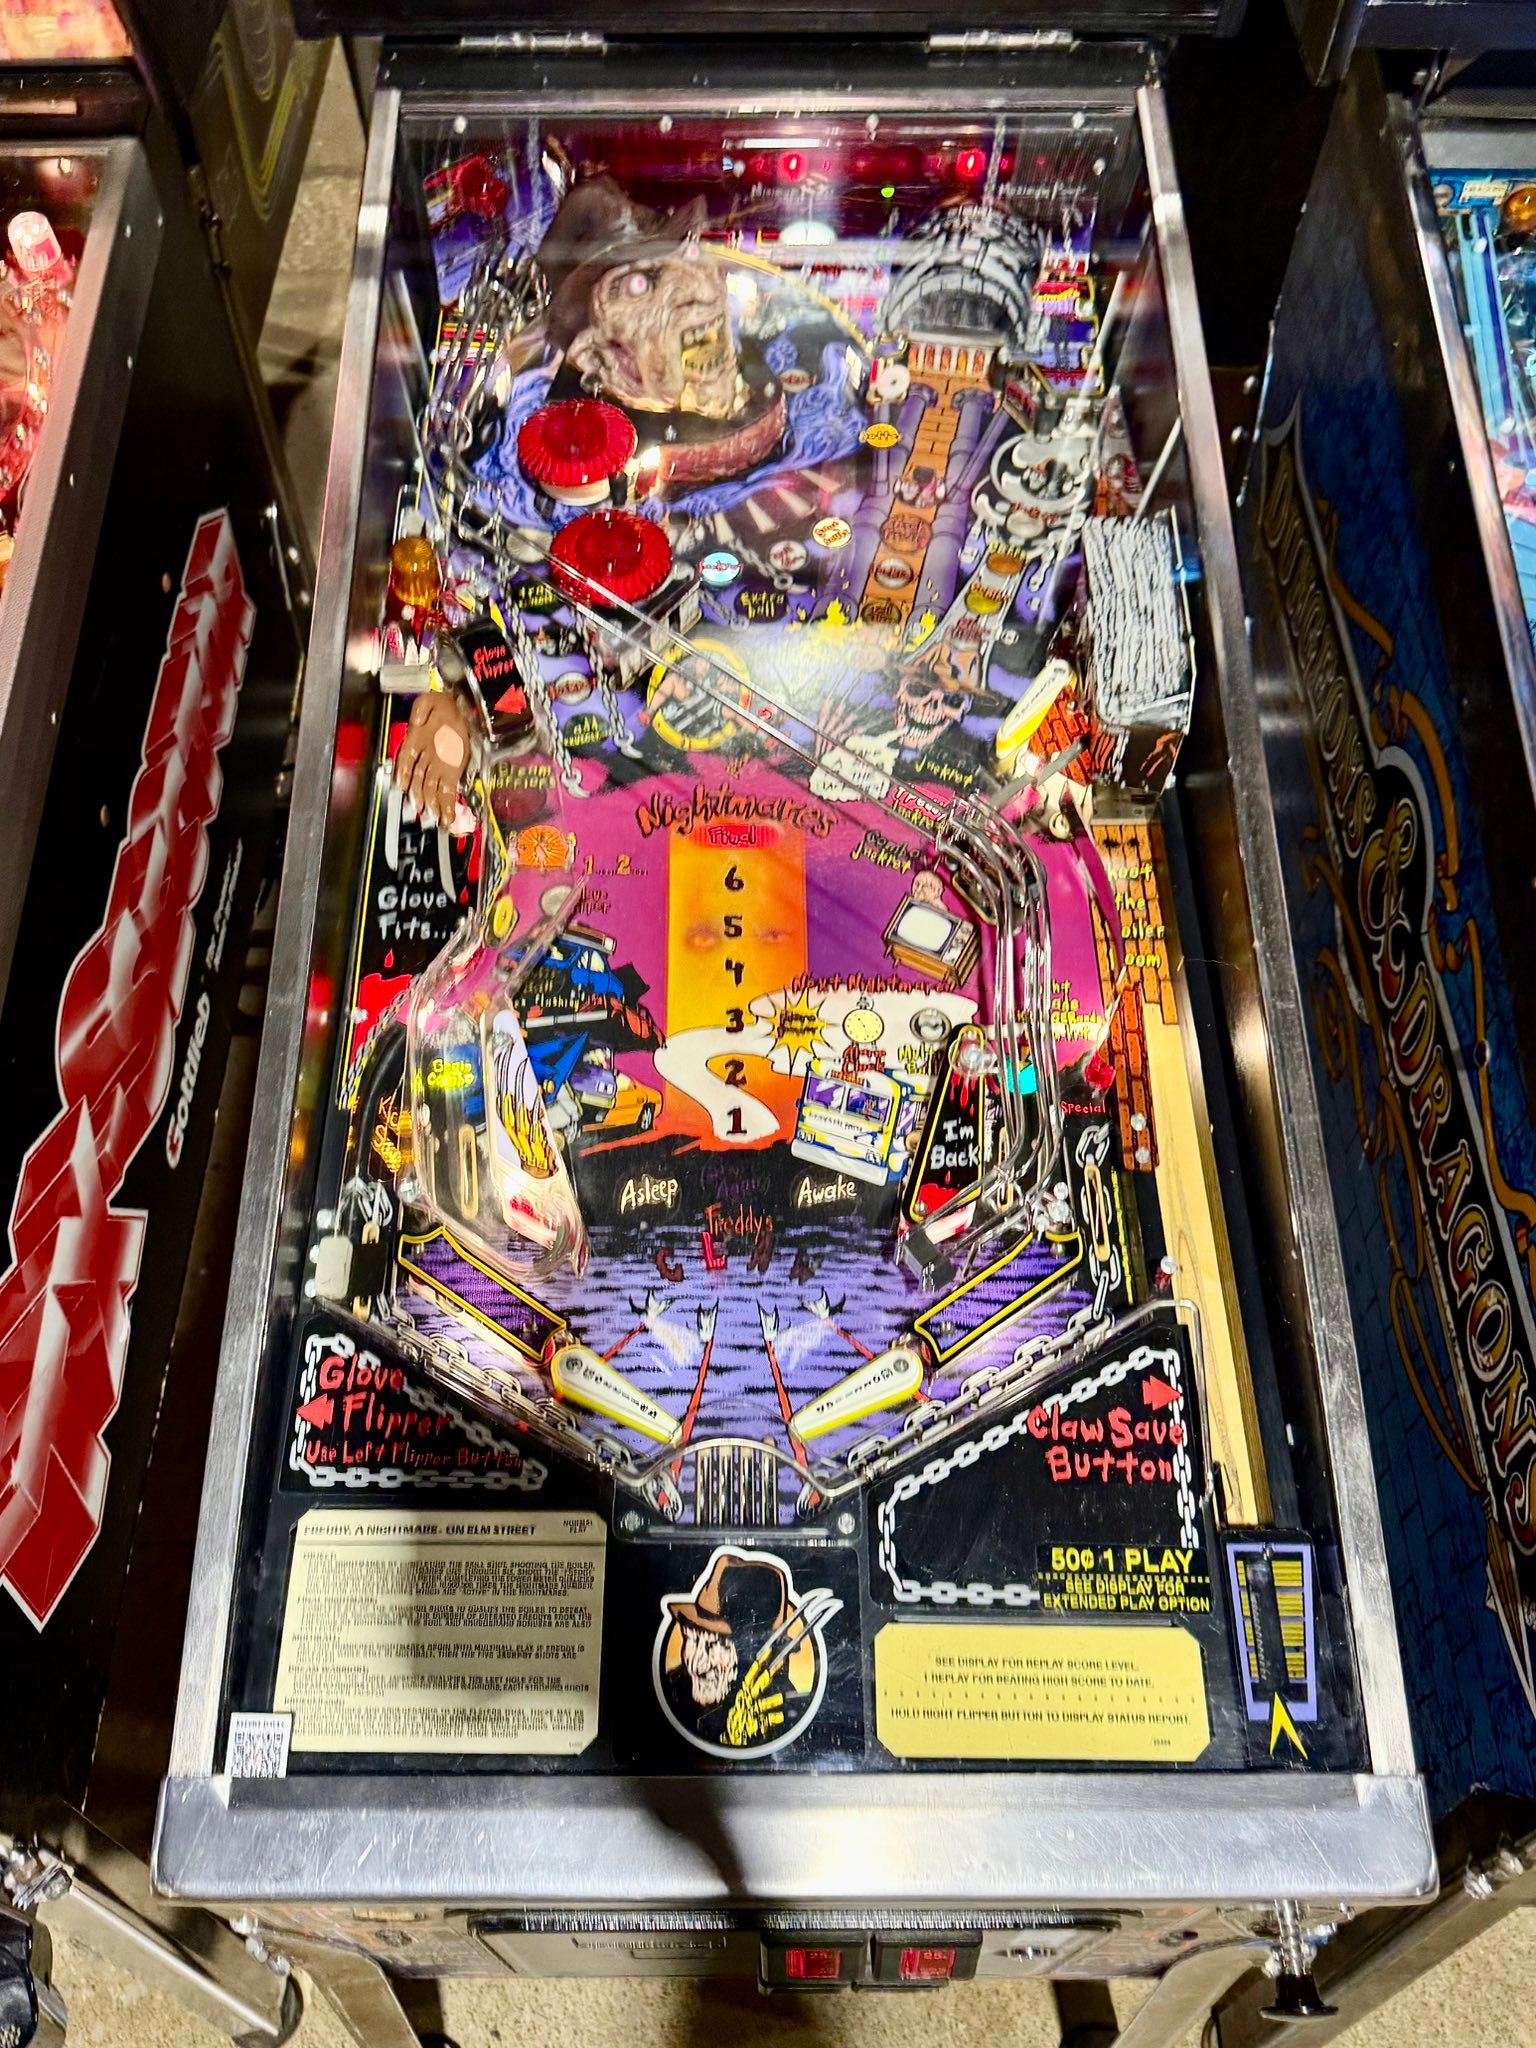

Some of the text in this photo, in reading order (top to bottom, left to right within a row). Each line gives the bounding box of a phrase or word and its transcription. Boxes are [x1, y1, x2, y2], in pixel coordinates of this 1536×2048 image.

[635, 783, 838, 838] Nightmares
[708, 825, 756, 845] Final
[398, 857, 434, 884] The
[724, 866, 744, 891] 6
[378, 885, 447, 911] Glove
[724, 915, 742, 938] 5
[725, 958, 744, 986] 4
[791, 972, 841, 993] Next
[725, 1008, 744, 1033] 3
[166, 991, 210, 1169] Gottlieb
[725, 1059, 747, 1087] 2
[726, 1106, 747, 1135] 1
[1061, 1100, 1106, 1115] Special
[943, 1118, 975, 1141] I'm
[930, 1144, 980, 1171] Back
[620, 1174, 679, 1215] Asleep
[797, 1175, 857, 1210] Awake
[319, 1353, 407, 1391] Glove
[342, 1391, 451, 1440] Flipper
[1026, 1402, 1184, 1450] Claw Save
[306, 1439, 338, 1464] Use
[342, 1440, 385, 1465] Left
[391, 1441, 451, 1467] Flipper
[1044, 1445, 1174, 1487] Button
[467, 1525, 491, 1535] ELM
[493, 1525, 536, 1536] STREET
[1051, 1547, 1194, 1574] 50¢ 1 PLAY
[1065, 1577, 1186, 1597] SEE DISPLAY FOR
[1043, 1592, 1211, 1613] EXTENDED PLAY OPTION
[935, 1656, 955, 1667] SEE
[958, 1656, 999, 1668] DISPLAY
[1003, 1658, 1023, 1668] FOR
[1026, 1658, 1064, 1670] REPLAY
[1067, 1659, 1103, 1670] SCORE
[931, 1672, 969, 1684] REPLAY
[973, 1674, 993, 1684] FOR
[1071, 1676, 1107, 1687] SCORE
[1110, 1677, 1123, 1688] TO
[891, 1707, 920, 1719] HOLD
[923, 1708, 954, 1720] RIGHT
[957, 1710, 999, 1721] FLIPPER
[1001, 1711, 1043, 1722] BUTTON
[1047, 1711, 1060, 1722] TO
[1062, 1712, 1104, 1724] DISPLAY
[1107, 1713, 1146, 1725] STATUS
